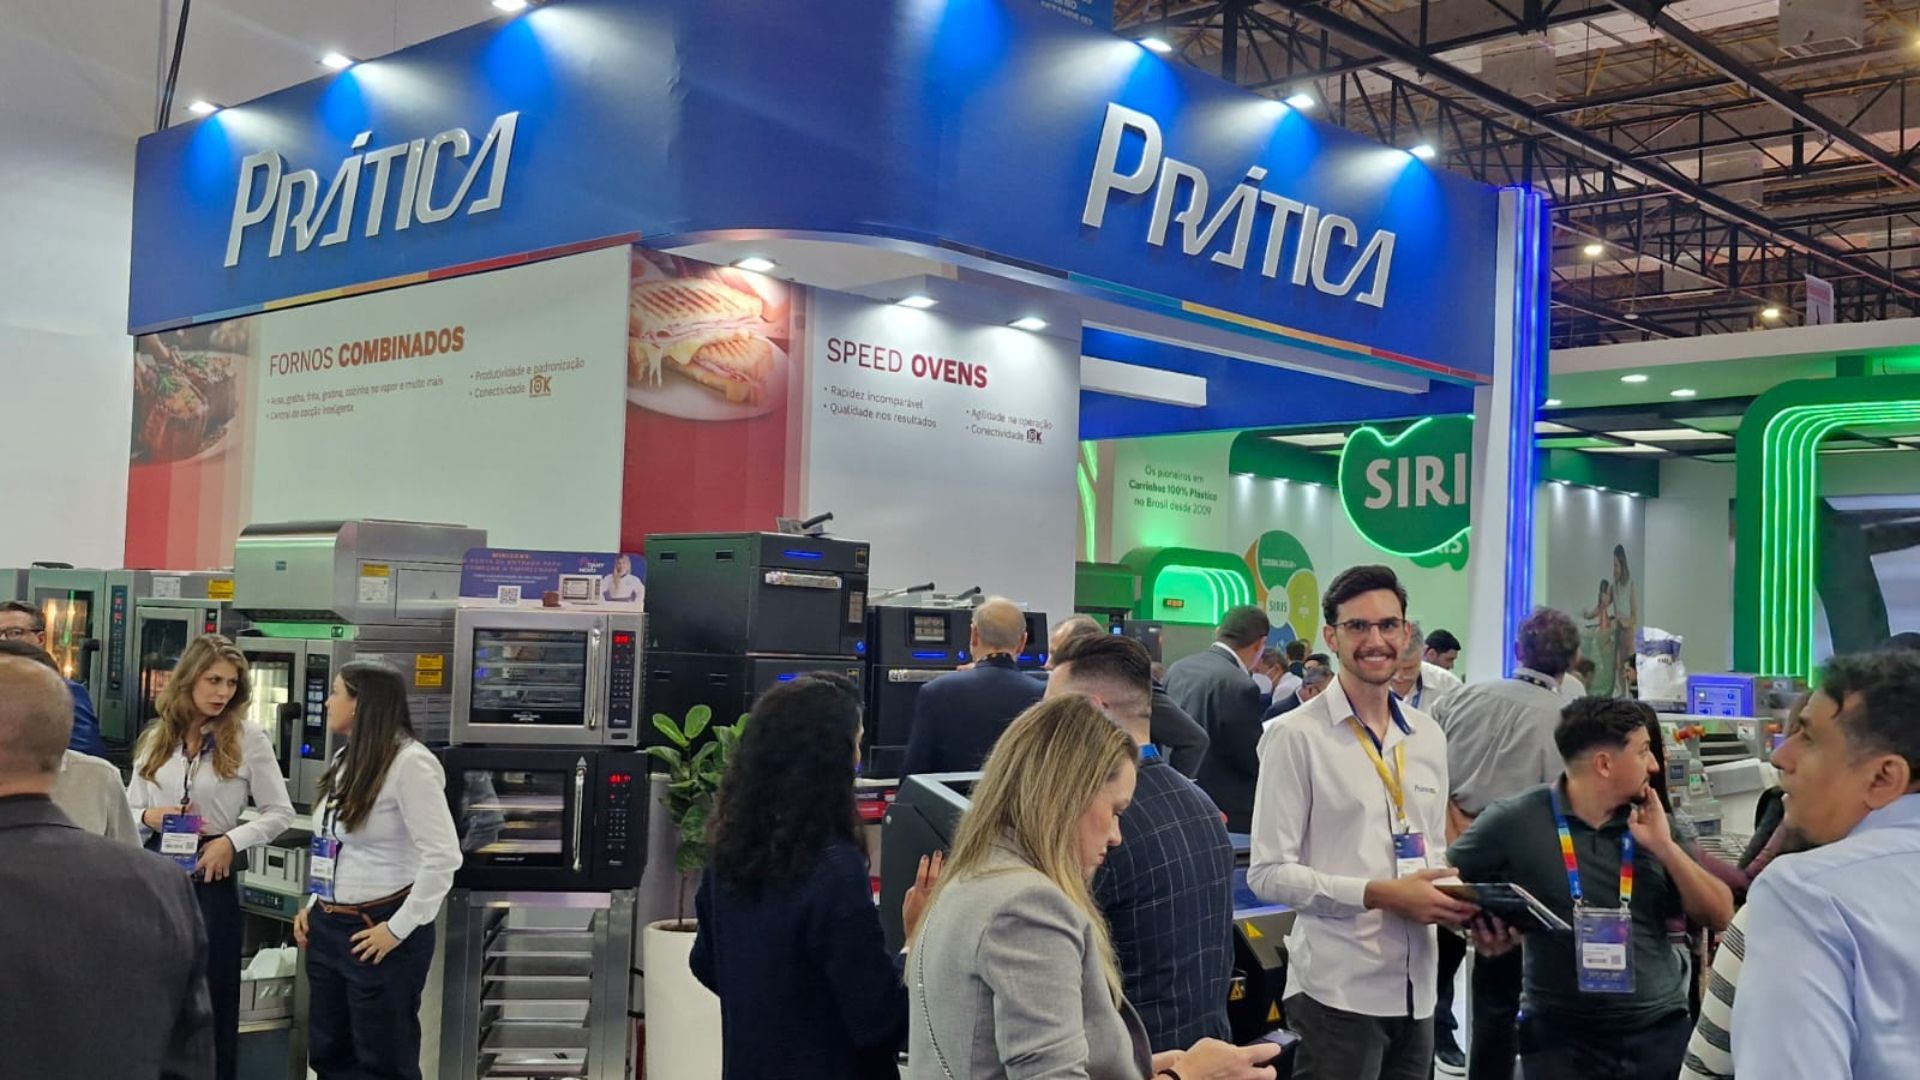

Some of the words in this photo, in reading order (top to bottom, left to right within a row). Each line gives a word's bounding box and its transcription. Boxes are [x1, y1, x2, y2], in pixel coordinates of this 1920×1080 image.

[269, 347, 334, 376] FORNOS
[338, 326, 465, 367] COMBINADOS
[475, 365, 525, 381] Produtividade
[526, 366, 531, 375] e
[533, 357, 585, 374] padronização
[827, 337, 903, 373] SPEED
[911, 354, 988, 389] OVENS
[474, 384, 526, 398] Conectividade
[831, 386, 865, 400] Rapidez
[868, 391, 923, 409] incomparável
[830, 403, 874, 418] Qualidade
[876, 412, 891, 421] nos
[894, 413, 937, 428] resultados
[972, 409, 1005, 423] Agilidade
[1008, 416, 1017, 424] na
[1019, 417, 1053, 430] operação
[971, 424, 1024, 440] Conectividade
[1145, 464, 1156, 476] Os
[1158, 470, 1191, 482] pioneiros
[1129, 479, 1165, 493] Carrinhos
[1167, 484, 1188, 497] 100%
[1134, 498, 1144, 506] no
[1146, 497, 1168, 509] Brasil
[1170, 502, 1191, 513] desde
[1193, 504, 1212, 516] 2009
